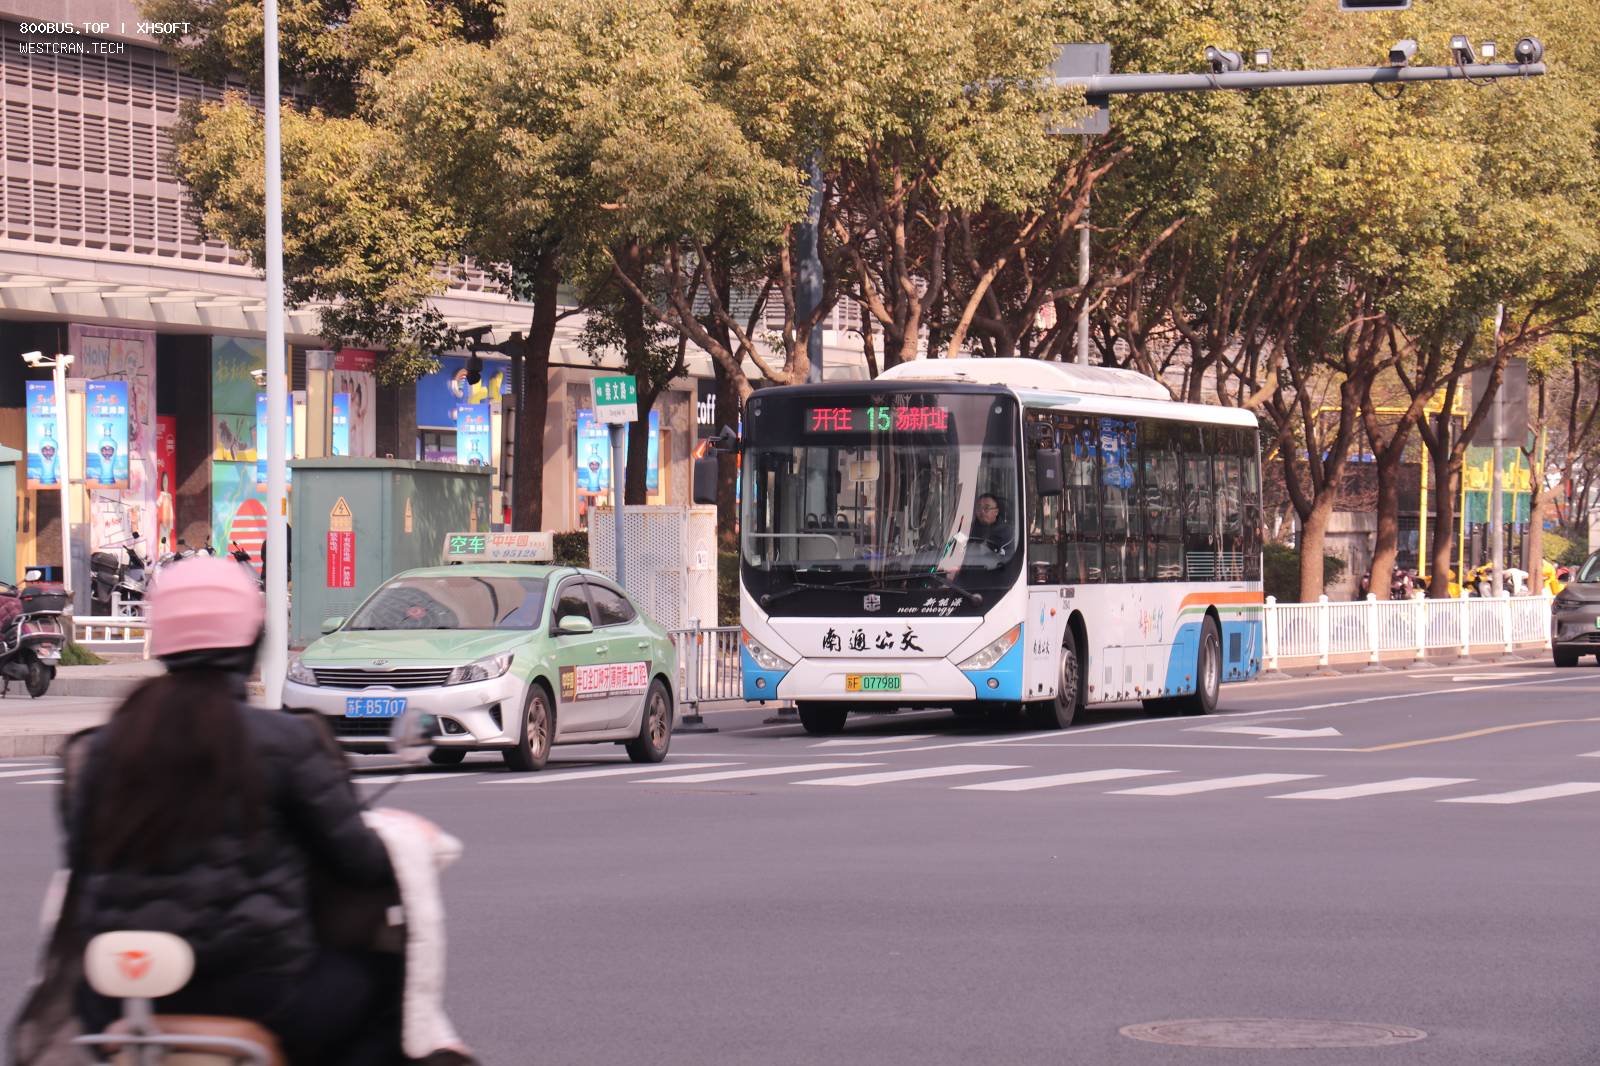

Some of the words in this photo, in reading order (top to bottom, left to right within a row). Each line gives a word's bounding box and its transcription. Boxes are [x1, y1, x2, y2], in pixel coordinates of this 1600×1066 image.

[812, 407, 853, 431] 开往
[866, 406, 890, 431] 15
[448, 535, 485, 555] 空车
[502, 549, 537, 558] 95128
[897, 606, 919, 614] new
[920, 604, 955, 617] energy
[822, 624, 924, 653] 南通公交
[863, 676, 900, 689] 07798D
